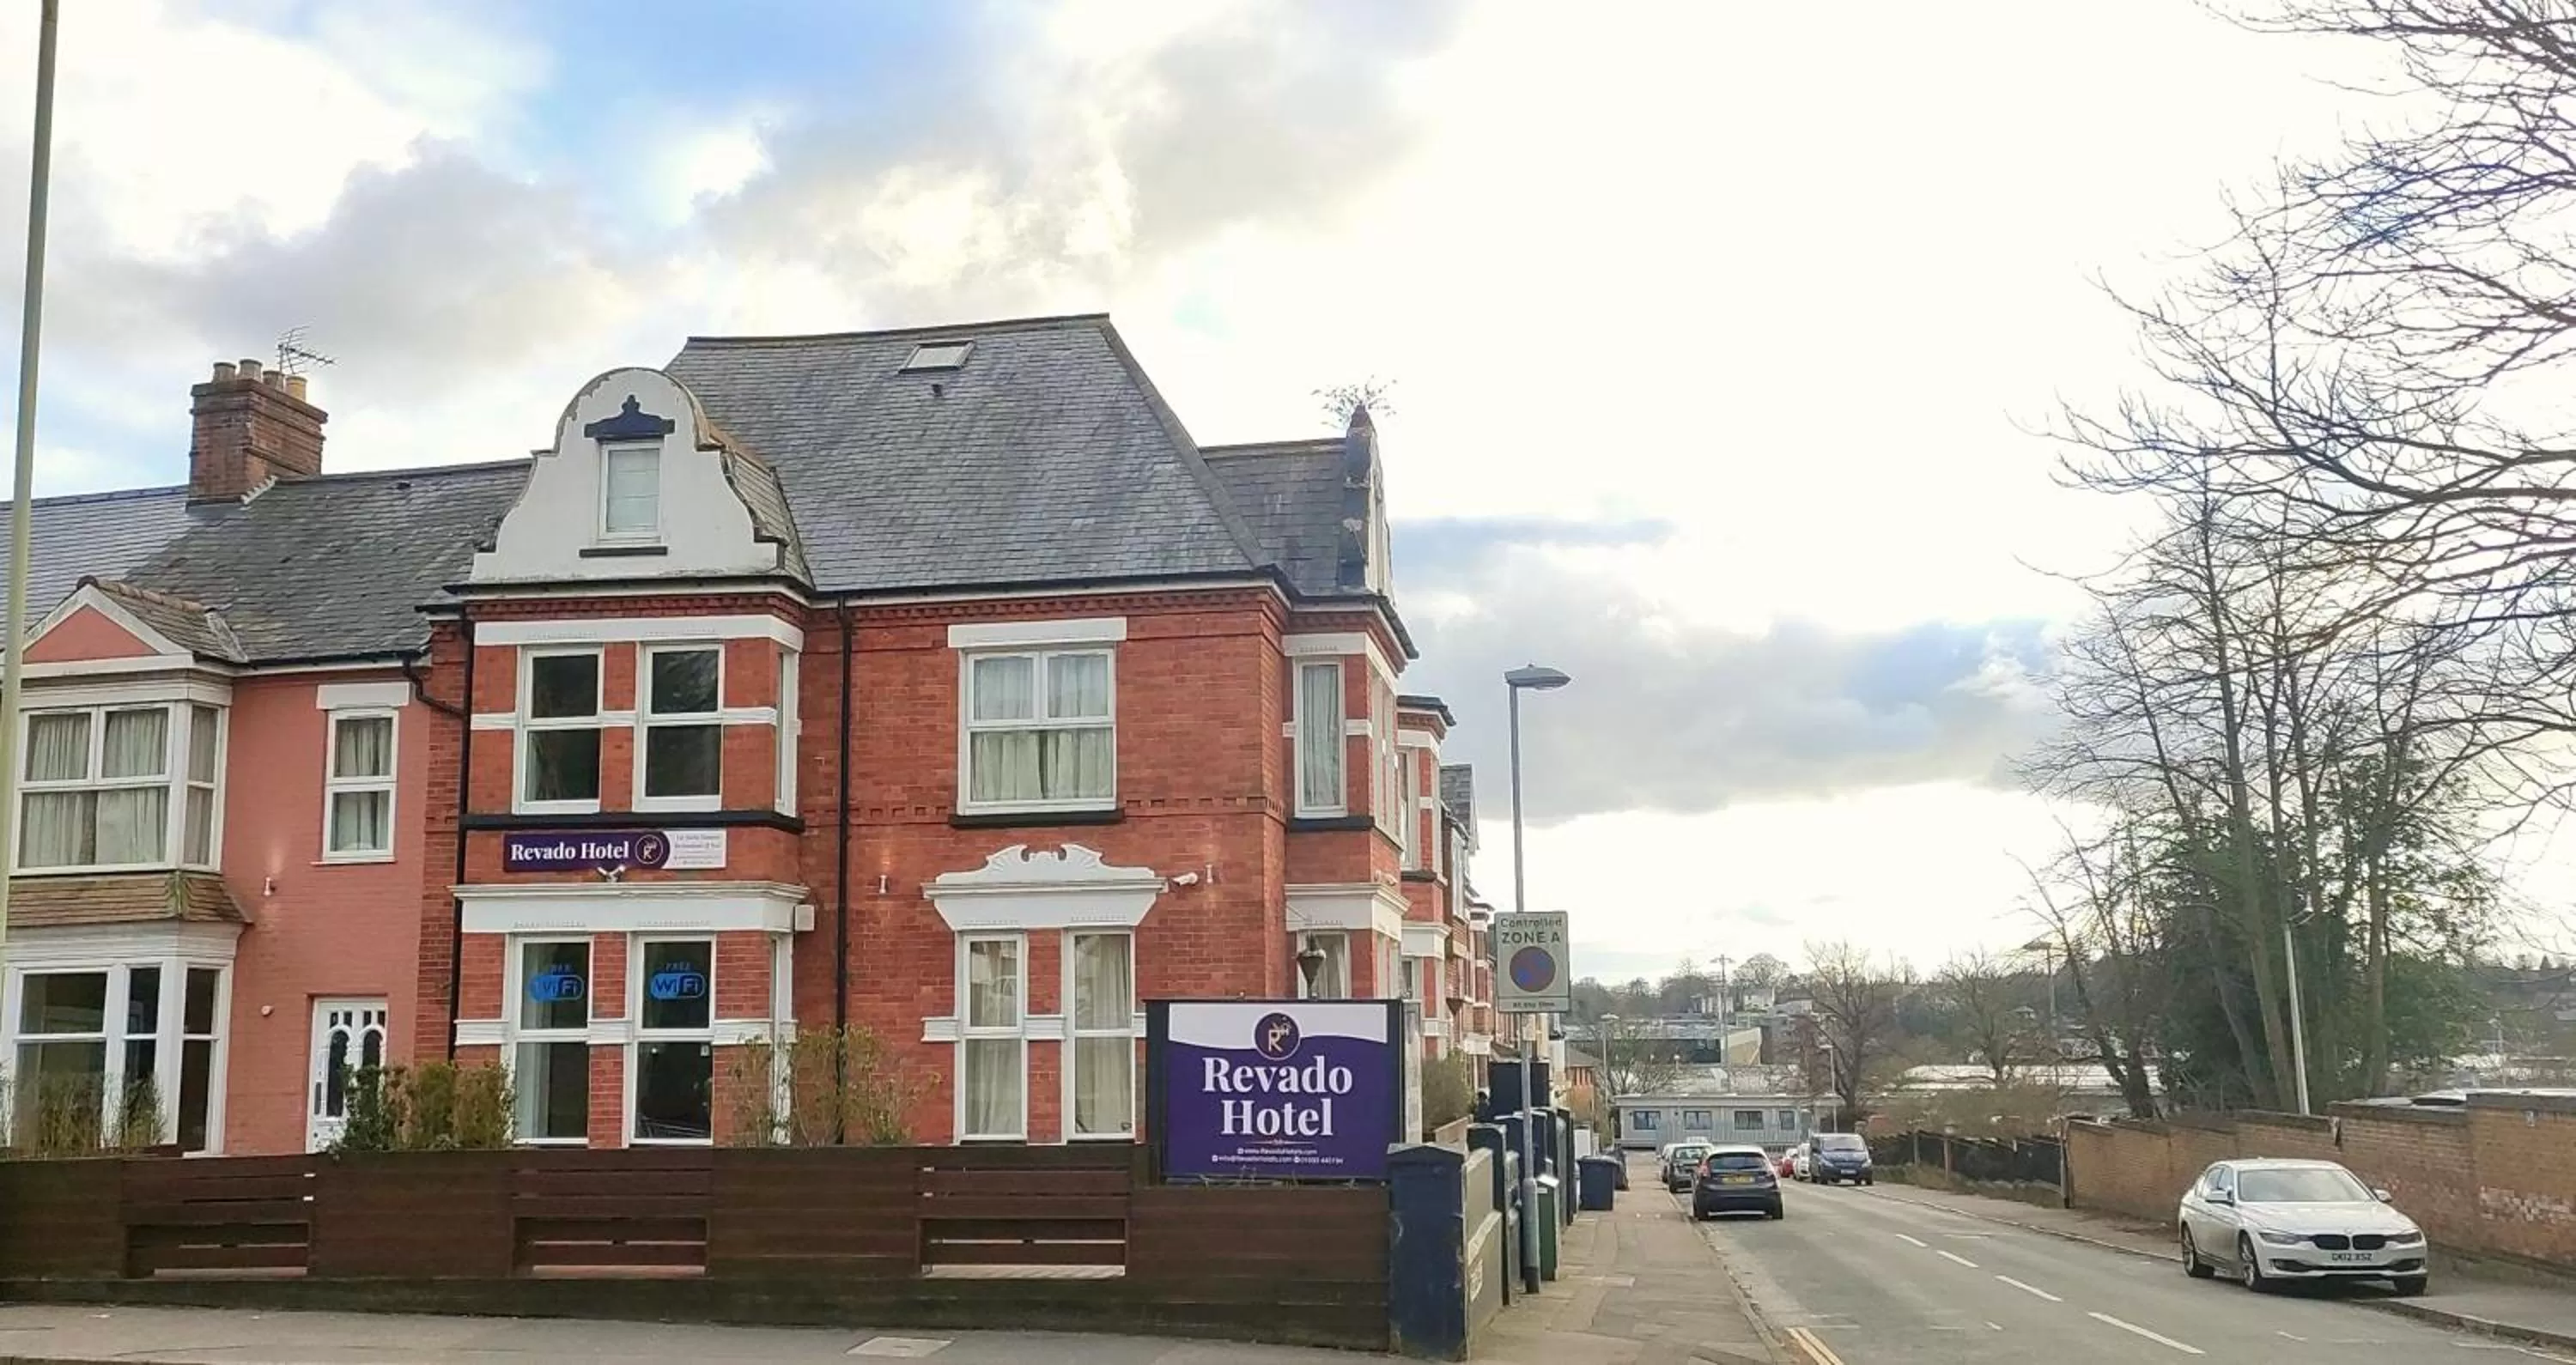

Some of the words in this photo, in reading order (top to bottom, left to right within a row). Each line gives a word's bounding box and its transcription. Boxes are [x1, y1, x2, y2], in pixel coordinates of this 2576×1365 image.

[510, 842, 576, 860] Revado
[580, 840, 629, 859] Hotel
[1500, 918, 1562, 928] Controlled
[1501, 931, 1546, 943] ZONE
[1551, 931, 1561, 943] A
[655, 977, 701, 994] WiFi
[1202, 1055, 1353, 1095] Revado
[1221, 1099, 1334, 1136] Hotel
